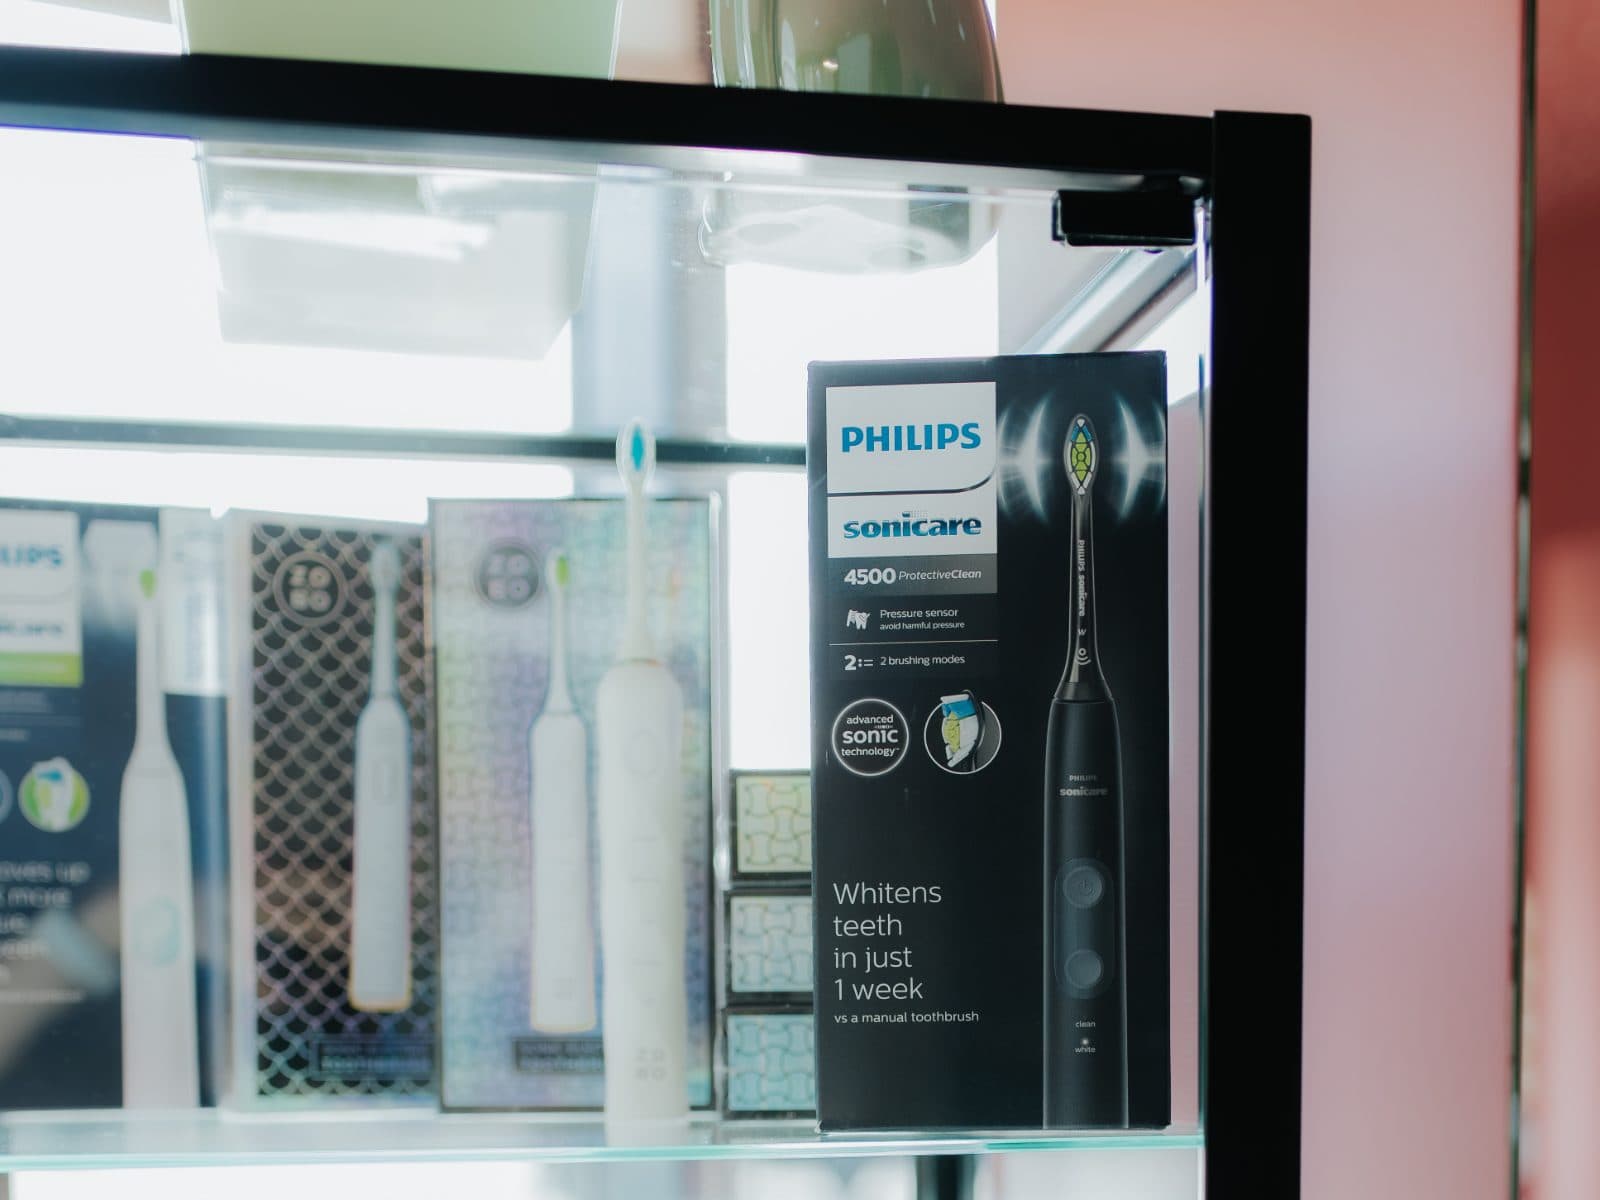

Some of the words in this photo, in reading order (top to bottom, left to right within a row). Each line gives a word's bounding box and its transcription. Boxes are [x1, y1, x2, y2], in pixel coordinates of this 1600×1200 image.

[842, 423, 981, 453] PHILIPS
[843, 511, 982, 540] sonicare
[844, 567, 896, 586] 4500
[898, 568, 982, 581] ProtectiveClean
[1078, 574, 1088, 617] sonicare
[880, 608, 922, 620] Pressure
[923, 608, 959, 618] sensor
[880, 621, 901, 631] avoid
[902, 620, 931, 631] harmful
[933, 620, 965, 632] pressure
[880, 656, 887, 666] 2
[888, 655, 931, 668] brushing
[932, 654, 966, 665] modes
[846, 714, 894, 725] advanced
[842, 724, 899, 745] sonic
[1059, 786, 1108, 797] sonicare
[832, 882, 942, 906] Whitens
[832, 914, 903, 938] teeth
[833, 948, 857, 969] in
[864, 947, 913, 973] just
[834, 979, 844, 1001] 1
[852, 977, 924, 1001] week
[834, 1014, 848, 1024] vs
[850, 1014, 859, 1023] a
[861, 1011, 908, 1024] manual
[910, 1010, 980, 1023] toothbrush
[1075, 1019, 1096, 1028] clean
[1075, 1044, 1096, 1054] white
